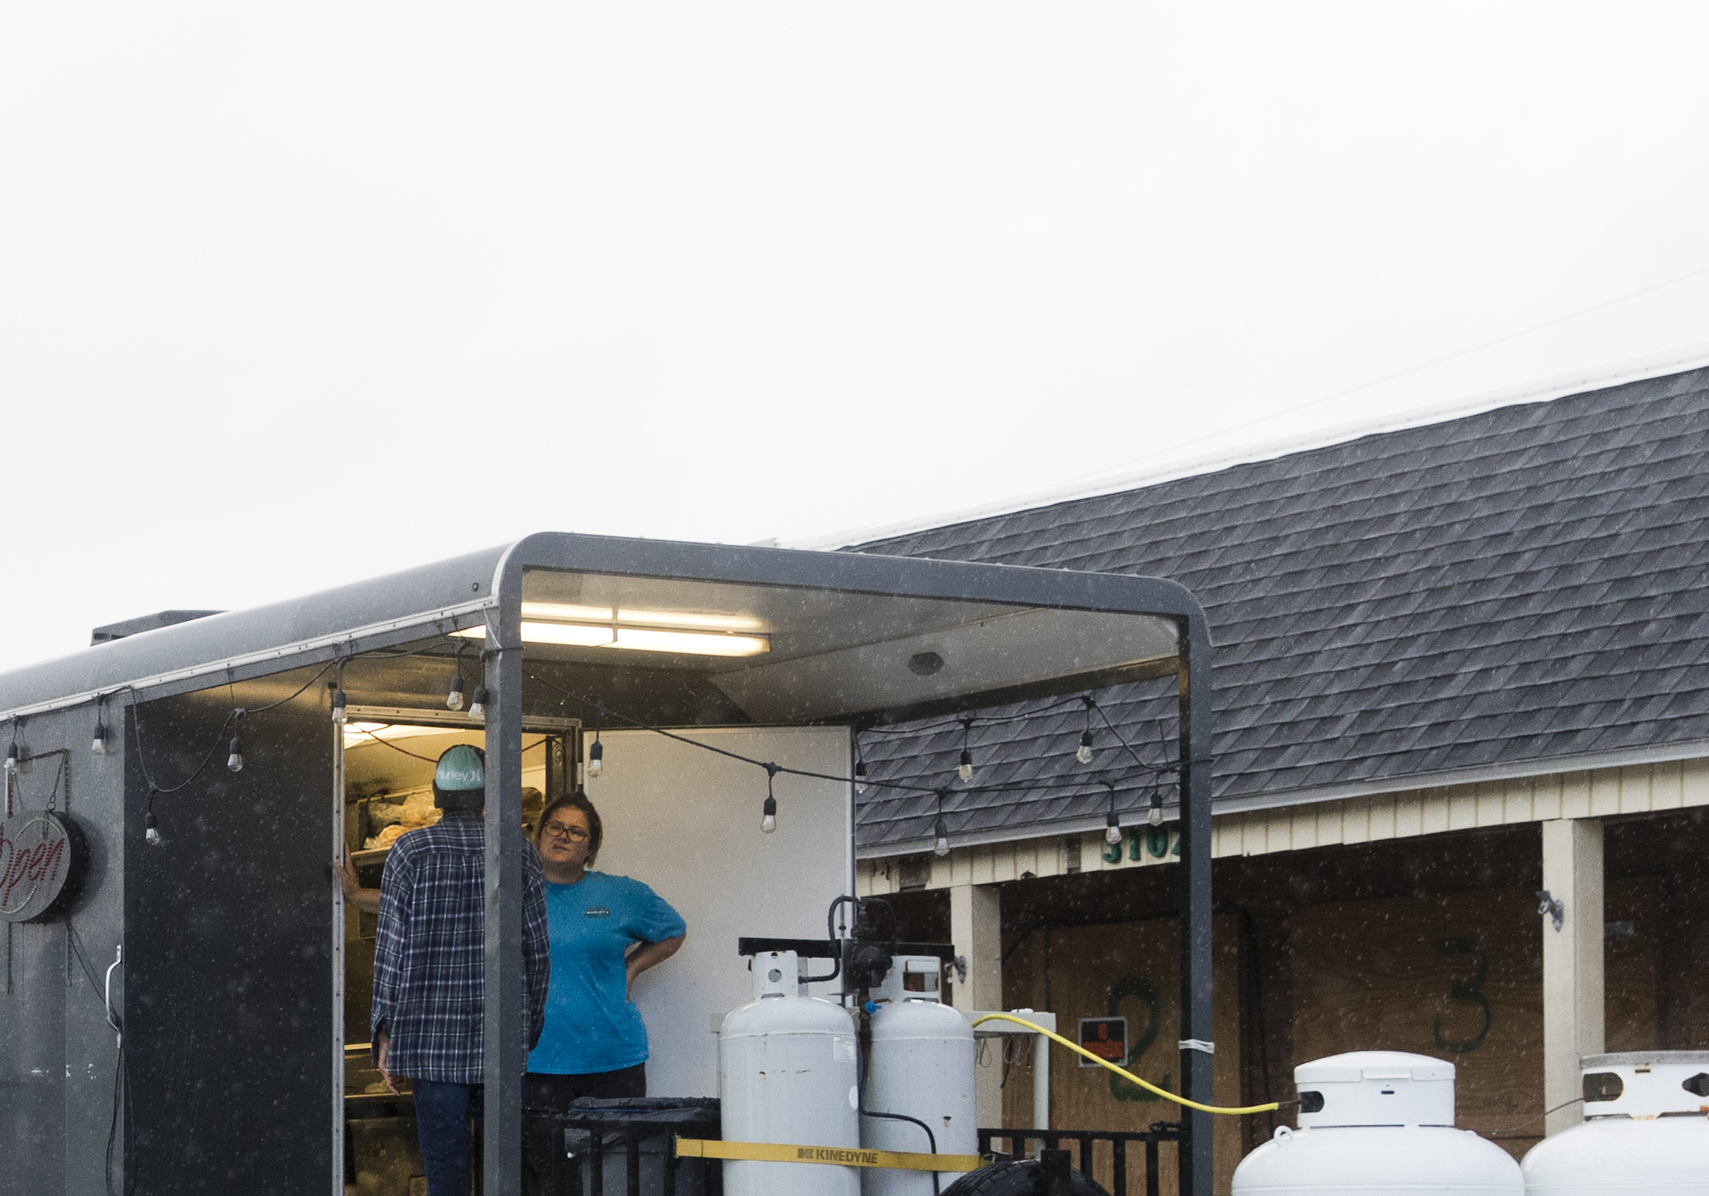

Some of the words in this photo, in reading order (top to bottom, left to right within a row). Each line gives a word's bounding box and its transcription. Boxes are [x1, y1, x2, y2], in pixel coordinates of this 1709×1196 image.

[1108, 975, 1171, 1102] 2
[1434, 937, 1490, 1054] 3
[816, 1148, 878, 1164] KINEDYNE
